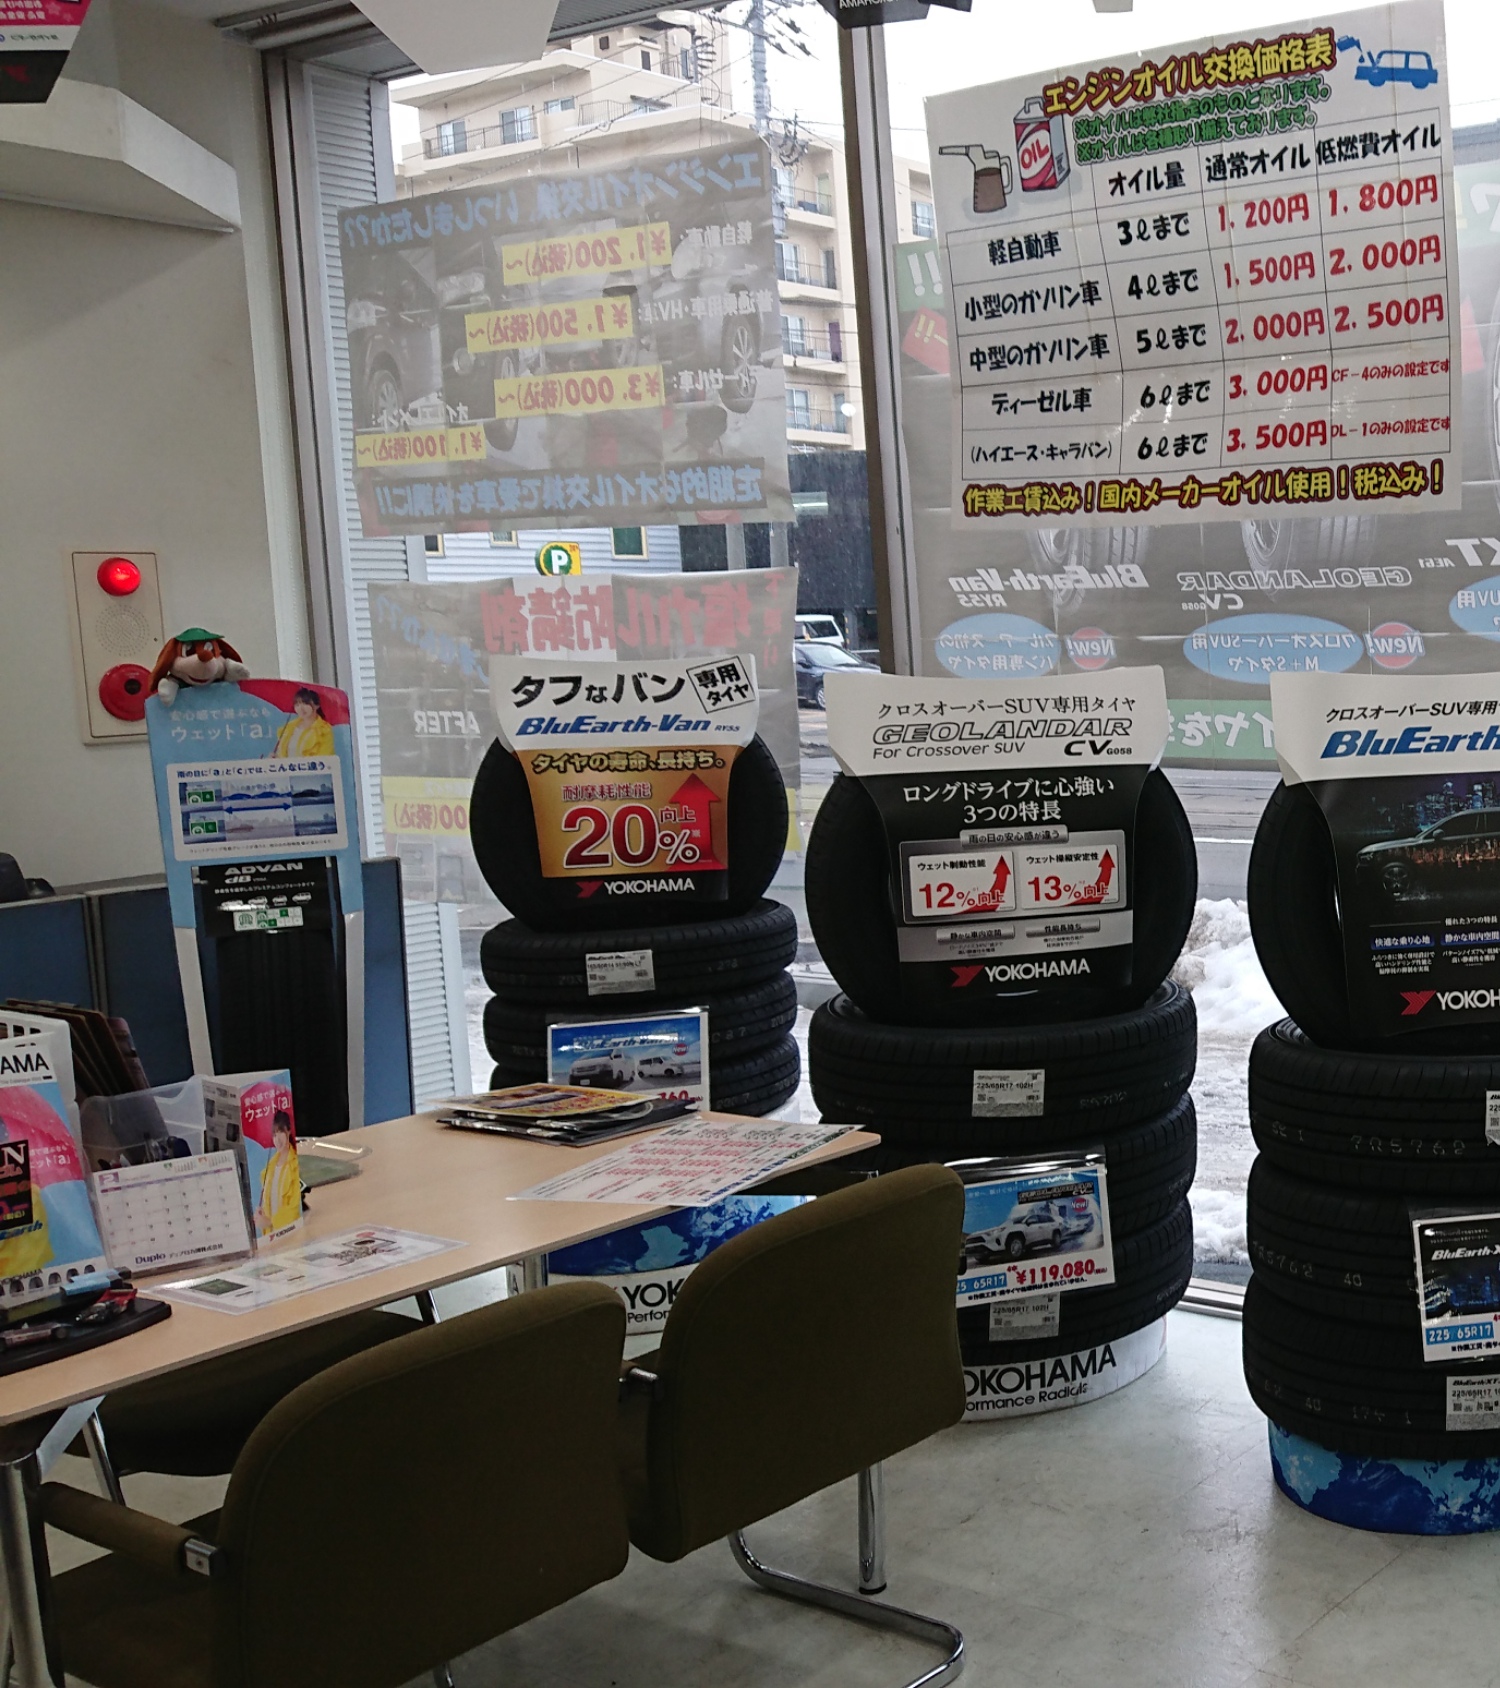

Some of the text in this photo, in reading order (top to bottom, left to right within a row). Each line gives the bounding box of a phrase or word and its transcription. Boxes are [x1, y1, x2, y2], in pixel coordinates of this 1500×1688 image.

[1044, 32, 1335, 116] エンジンオイル交換価格表
[1020, 138, 1050, 170] OIL
[1109, 123, 1442, 196] オイル量 通常オイル 低燃費オイル
[988, 233, 1062, 267] 軽自動車
[964, 280, 1102, 323] 小型のガソリン車
[969, 334, 1110, 370] 中型のガソリン車
[991, 388, 1093, 416] ディーゼル車
[551, 549, 568, 574] P
[694, 663, 740, 690] 専用
[511, 673, 685, 708] タフなバン
[706, 684, 750, 707] タイヤ
[879, 696, 1136, 719] クロスオーバーSUV専用タイヤ
[516, 714, 711, 736] BluEarth-Van
[873, 717, 1133, 745] GEOLANDAR
[873, 741, 1025, 759] For Crossover SUV
[1064, 740, 1111, 756] CV
[562, 783, 651, 801] 耐摩耗性能
[903, 776, 1115, 803] ロングドライブに心強い
[659, 806, 697, 823] 向上
[963, 800, 1062, 824] 3つの特長
[969, 830, 1059, 844] 雨の日の安心感が違う
[225, 862, 303, 875] ADVAN
[917, 859, 987, 872] ウェット制動性能
[604, 878, 695, 895] YOKOHAMA
[985, 958, 1091, 982] YOKOHAMA
[135, 1252, 166, 1264] Duplo
